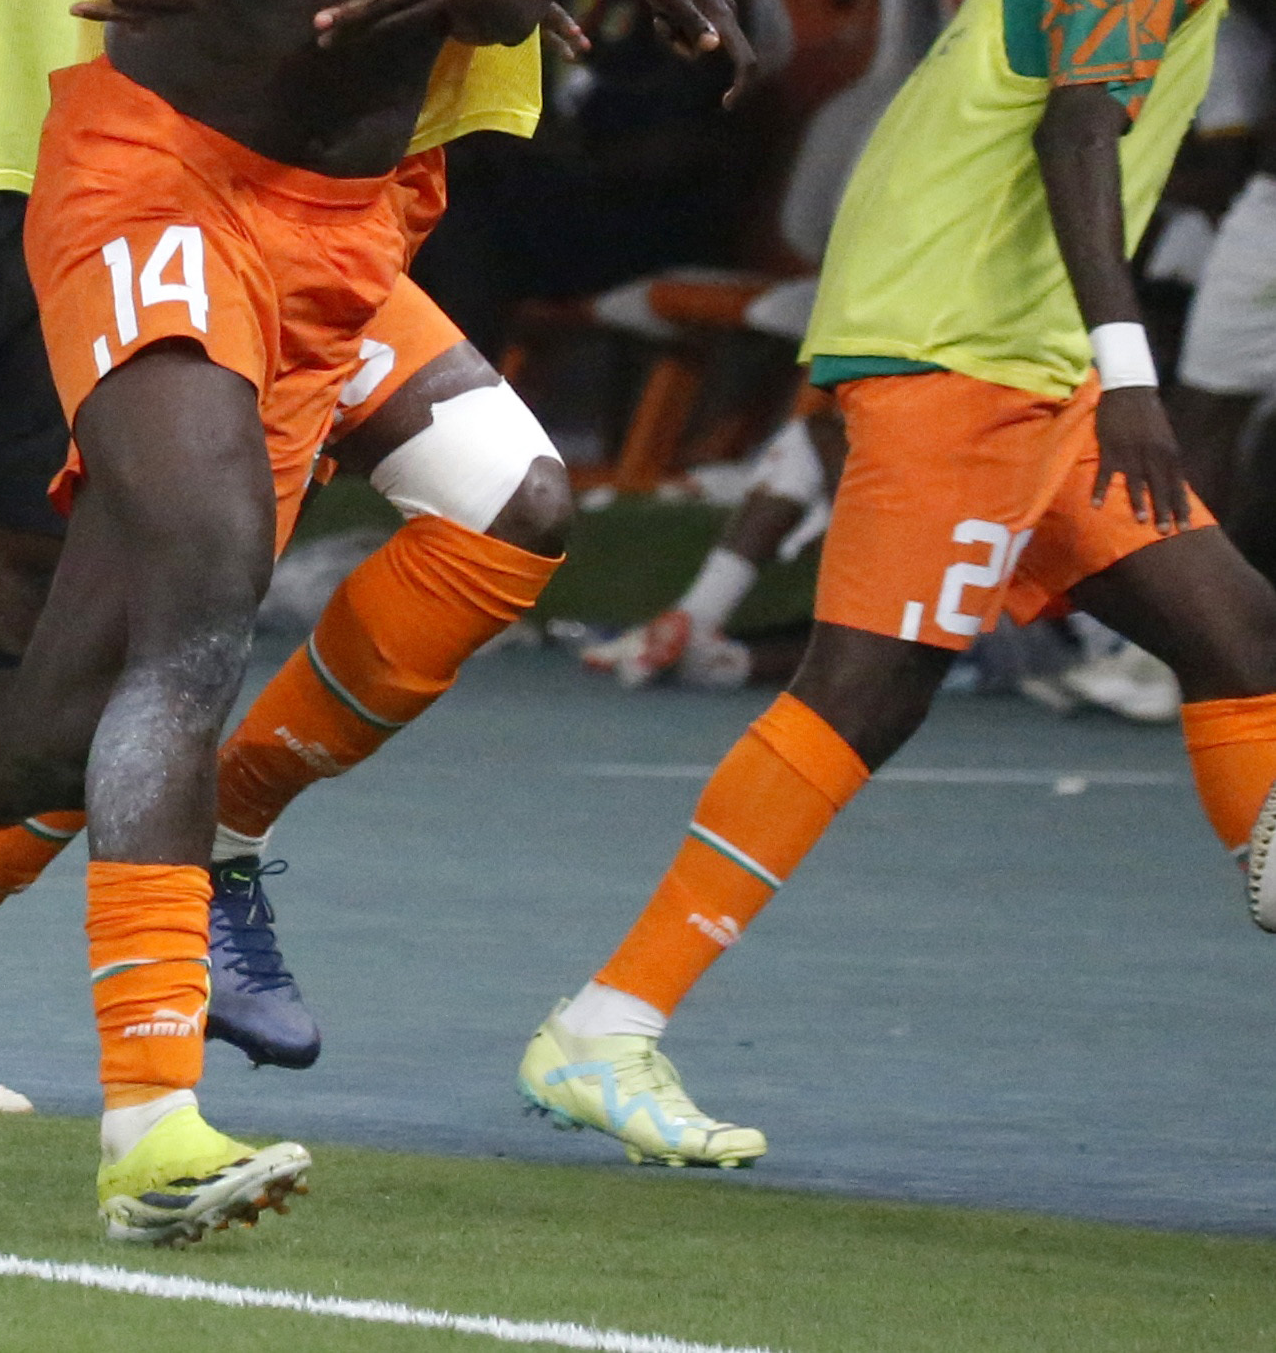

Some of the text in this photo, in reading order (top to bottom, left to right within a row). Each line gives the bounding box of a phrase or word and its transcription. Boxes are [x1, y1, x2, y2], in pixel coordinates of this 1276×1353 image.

[102, 224, 209, 347] 14
[934, 518, 1035, 636] 2
[123, 1021, 191, 1039] PUMA
